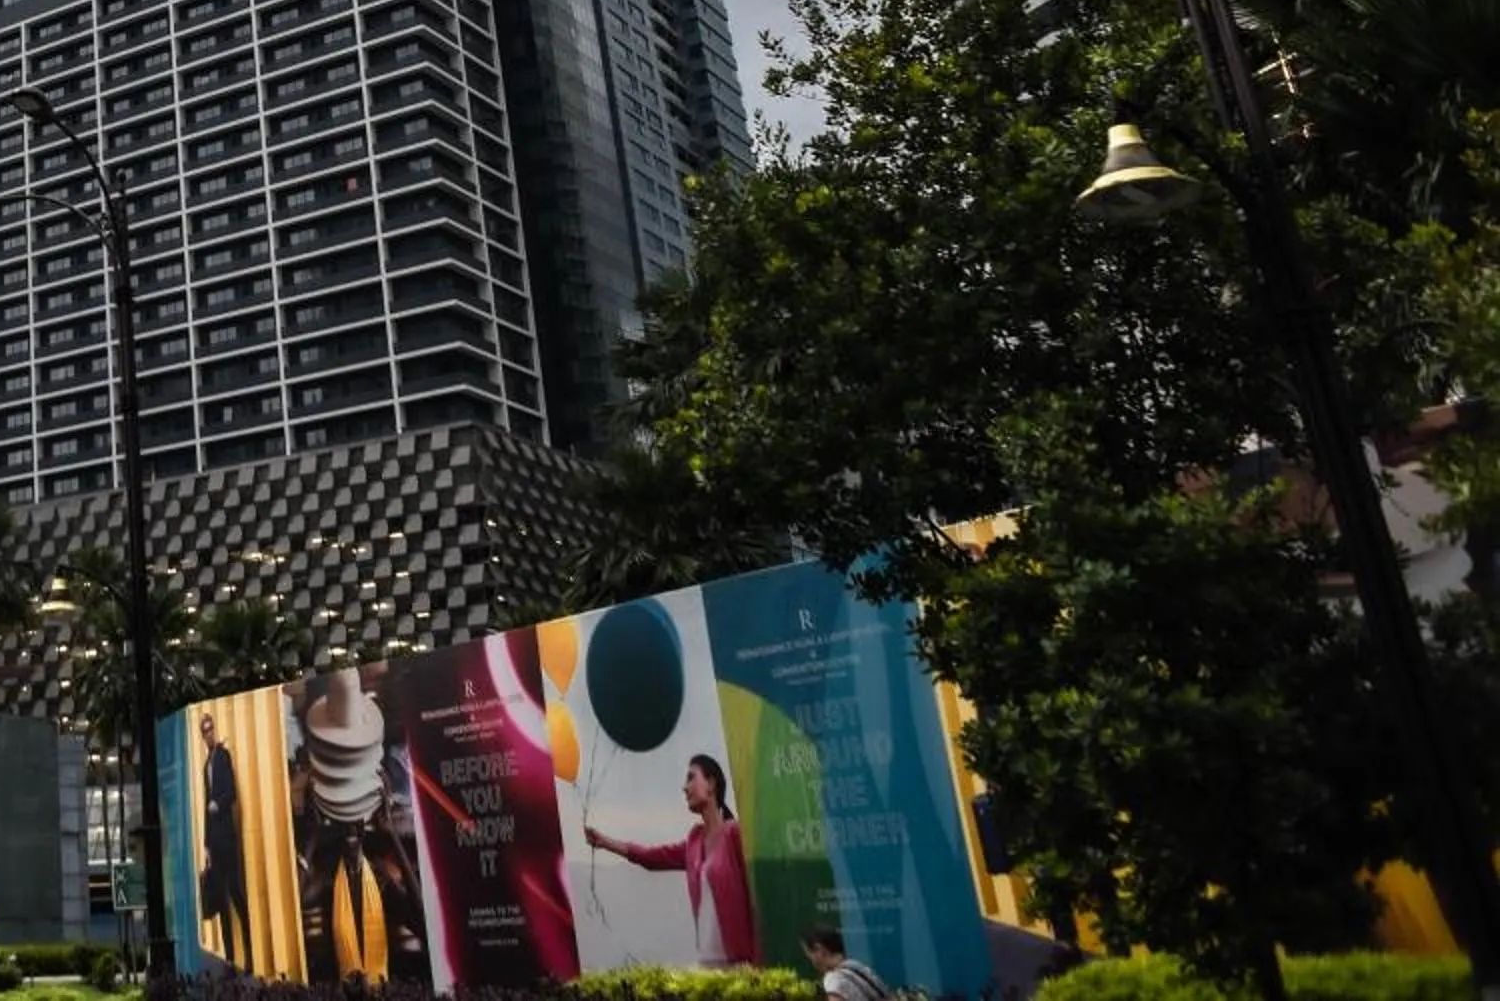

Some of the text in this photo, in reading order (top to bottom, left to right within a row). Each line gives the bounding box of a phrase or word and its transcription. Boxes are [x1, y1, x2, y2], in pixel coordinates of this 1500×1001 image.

[464, 679, 476, 697] R
[790, 696, 861, 737] JUST
[439, 750, 519, 786] BEFORE
[460, 783, 502, 815] YOU
[807, 773, 869, 810] THE
[455, 813, 516, 848] KNOW
[785, 811, 911, 855] CORNER
[478, 850, 500, 879] IT
